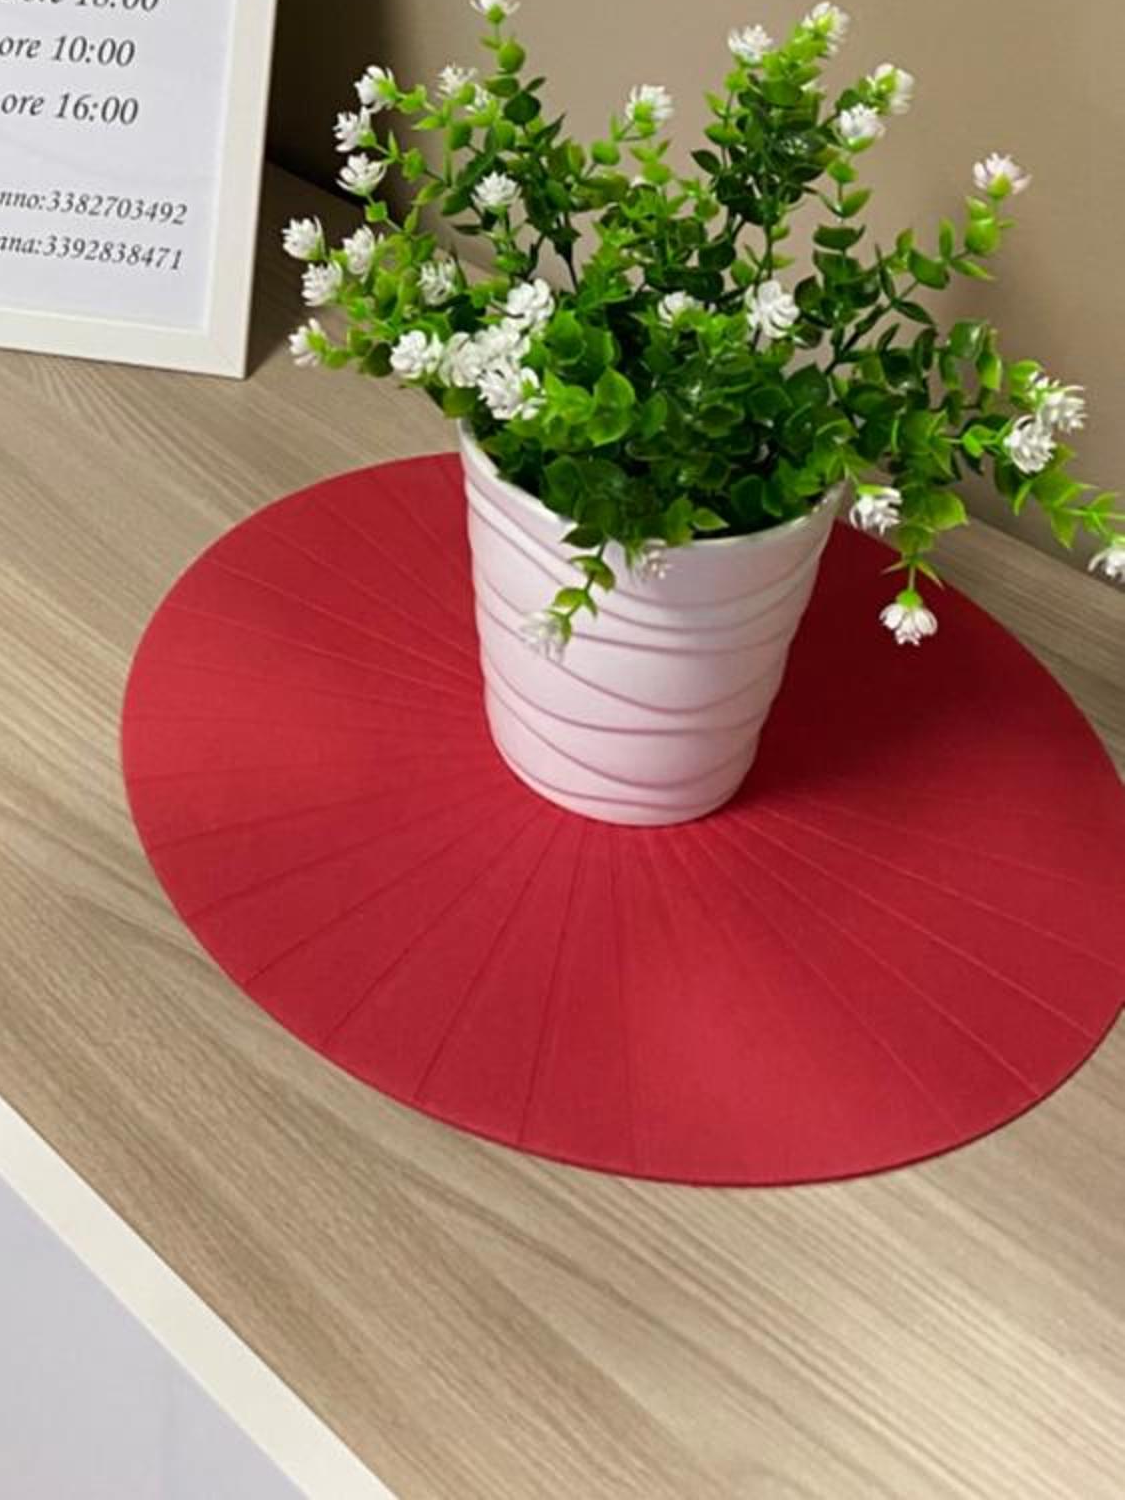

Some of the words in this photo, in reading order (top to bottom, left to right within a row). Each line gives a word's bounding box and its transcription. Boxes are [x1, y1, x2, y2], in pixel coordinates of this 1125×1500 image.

[51, 35, 136, 67] 10:00
[0, 93, 45, 117] ore
[55, 93, 140, 126] 16:00
